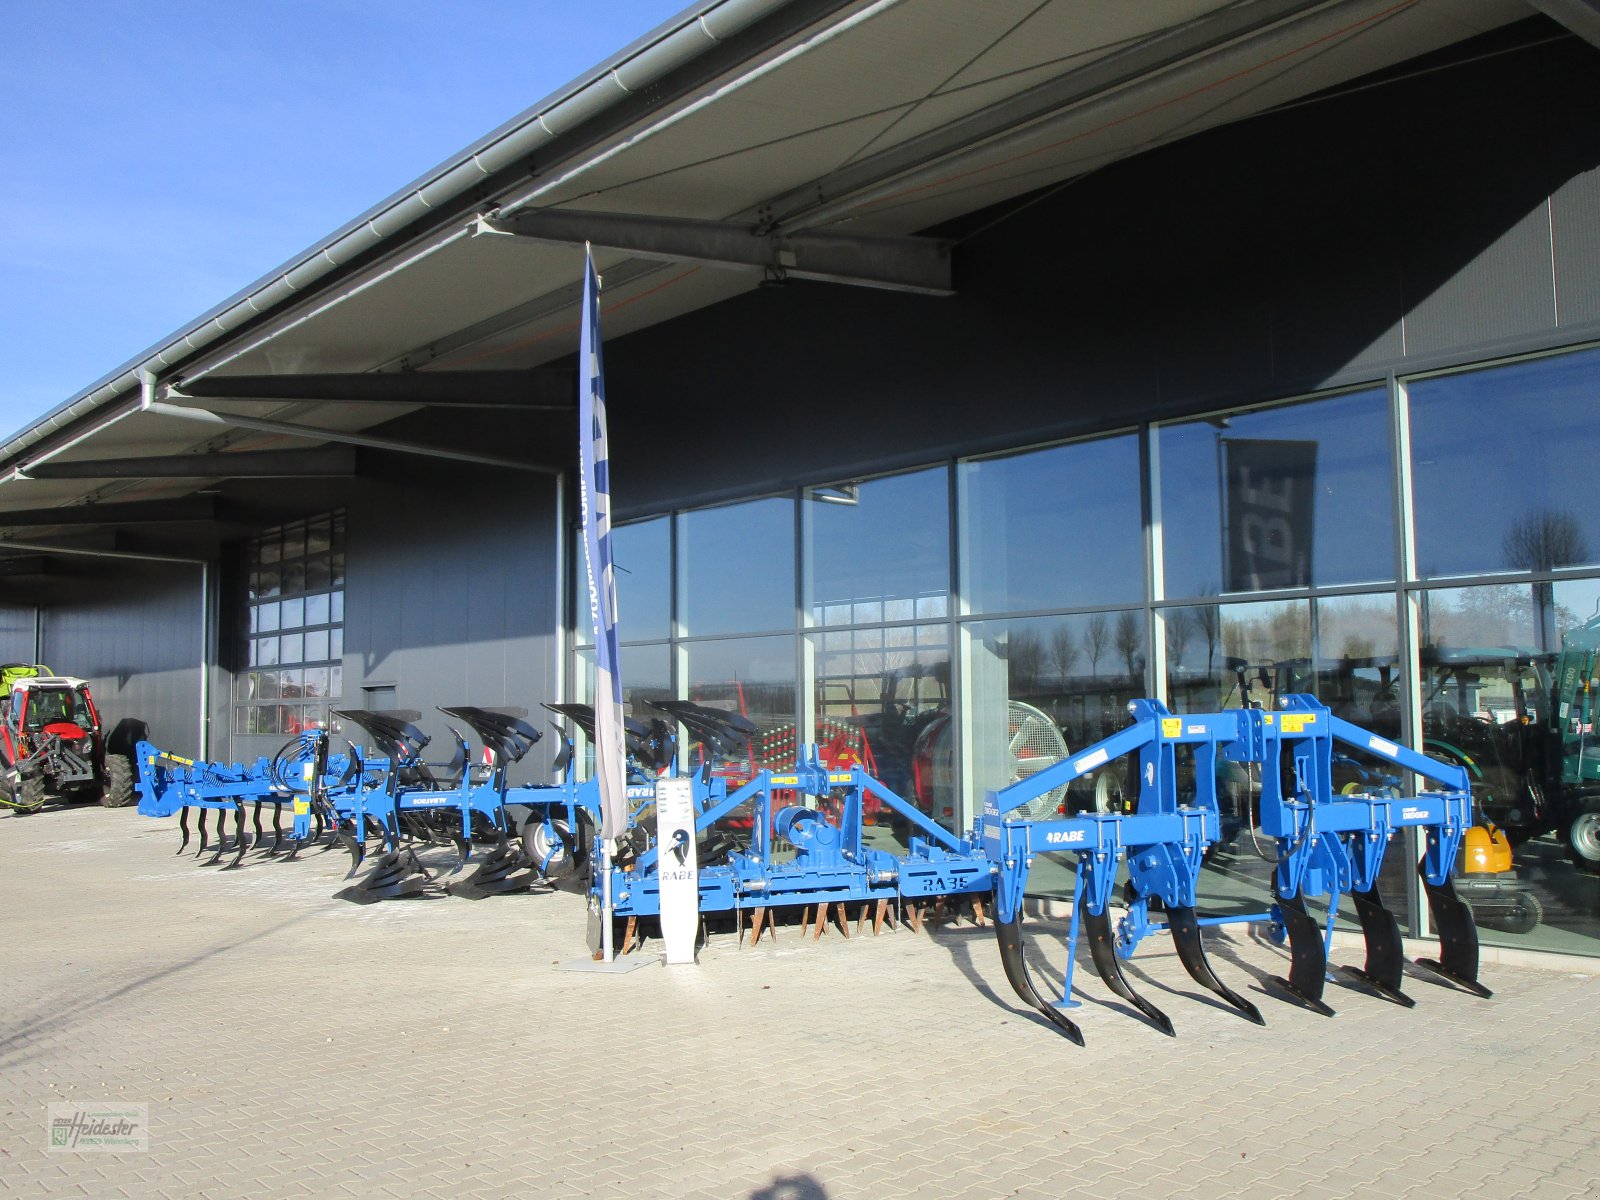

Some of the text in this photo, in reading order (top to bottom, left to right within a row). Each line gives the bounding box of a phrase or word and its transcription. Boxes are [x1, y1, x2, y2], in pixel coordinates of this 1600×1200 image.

[626, 787, 649, 797] RAB
[1402, 811, 1429, 820] DIGGER
[1053, 830, 1085, 843] RABE
[662, 871, 694, 881] RABE
[923, 875, 969, 892] RABE
